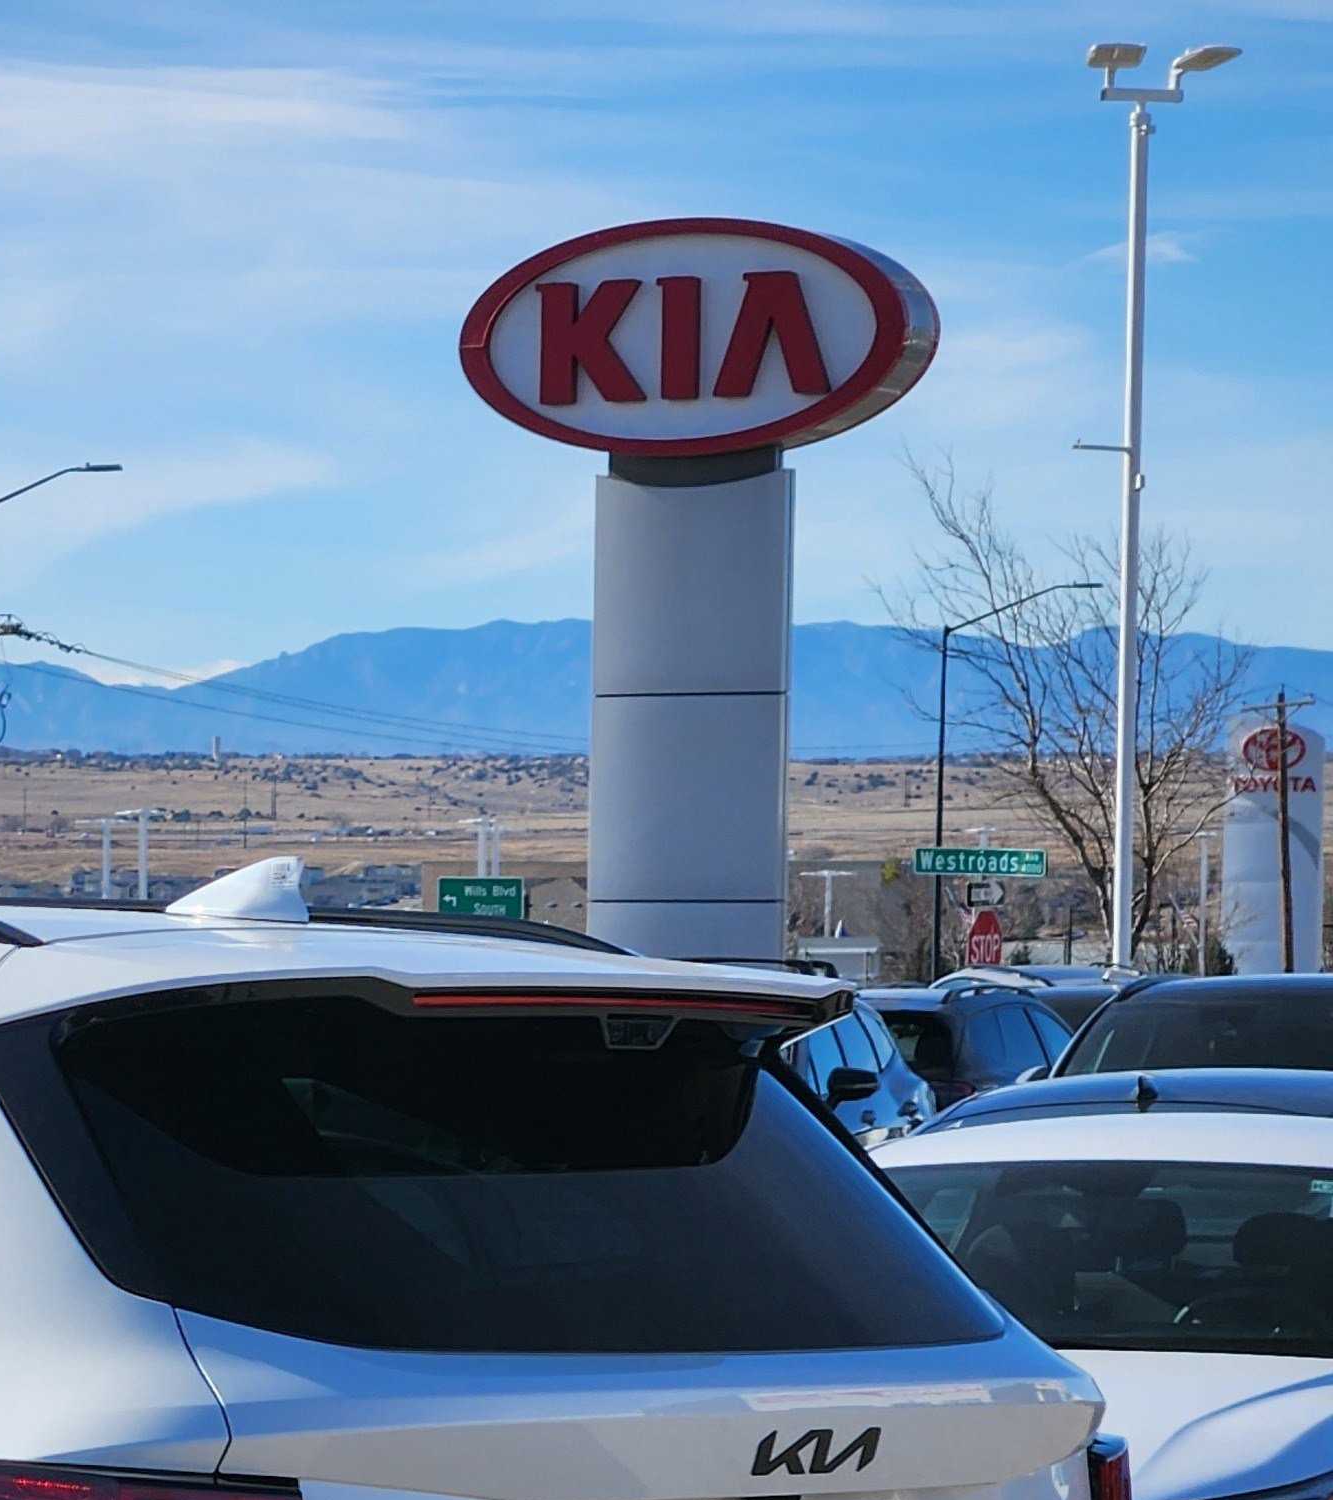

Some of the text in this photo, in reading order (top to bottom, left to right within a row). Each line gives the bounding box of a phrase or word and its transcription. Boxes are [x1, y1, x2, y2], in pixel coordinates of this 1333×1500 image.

[536, 270, 832, 407] KIA
[1232, 775, 1317, 792] TOYTA
[920, 851, 1018, 872] Westroads
[492, 885, 517, 897] Blvd
[970, 934, 1001, 963] STOP
[751, 1427, 882, 1476] KIA
